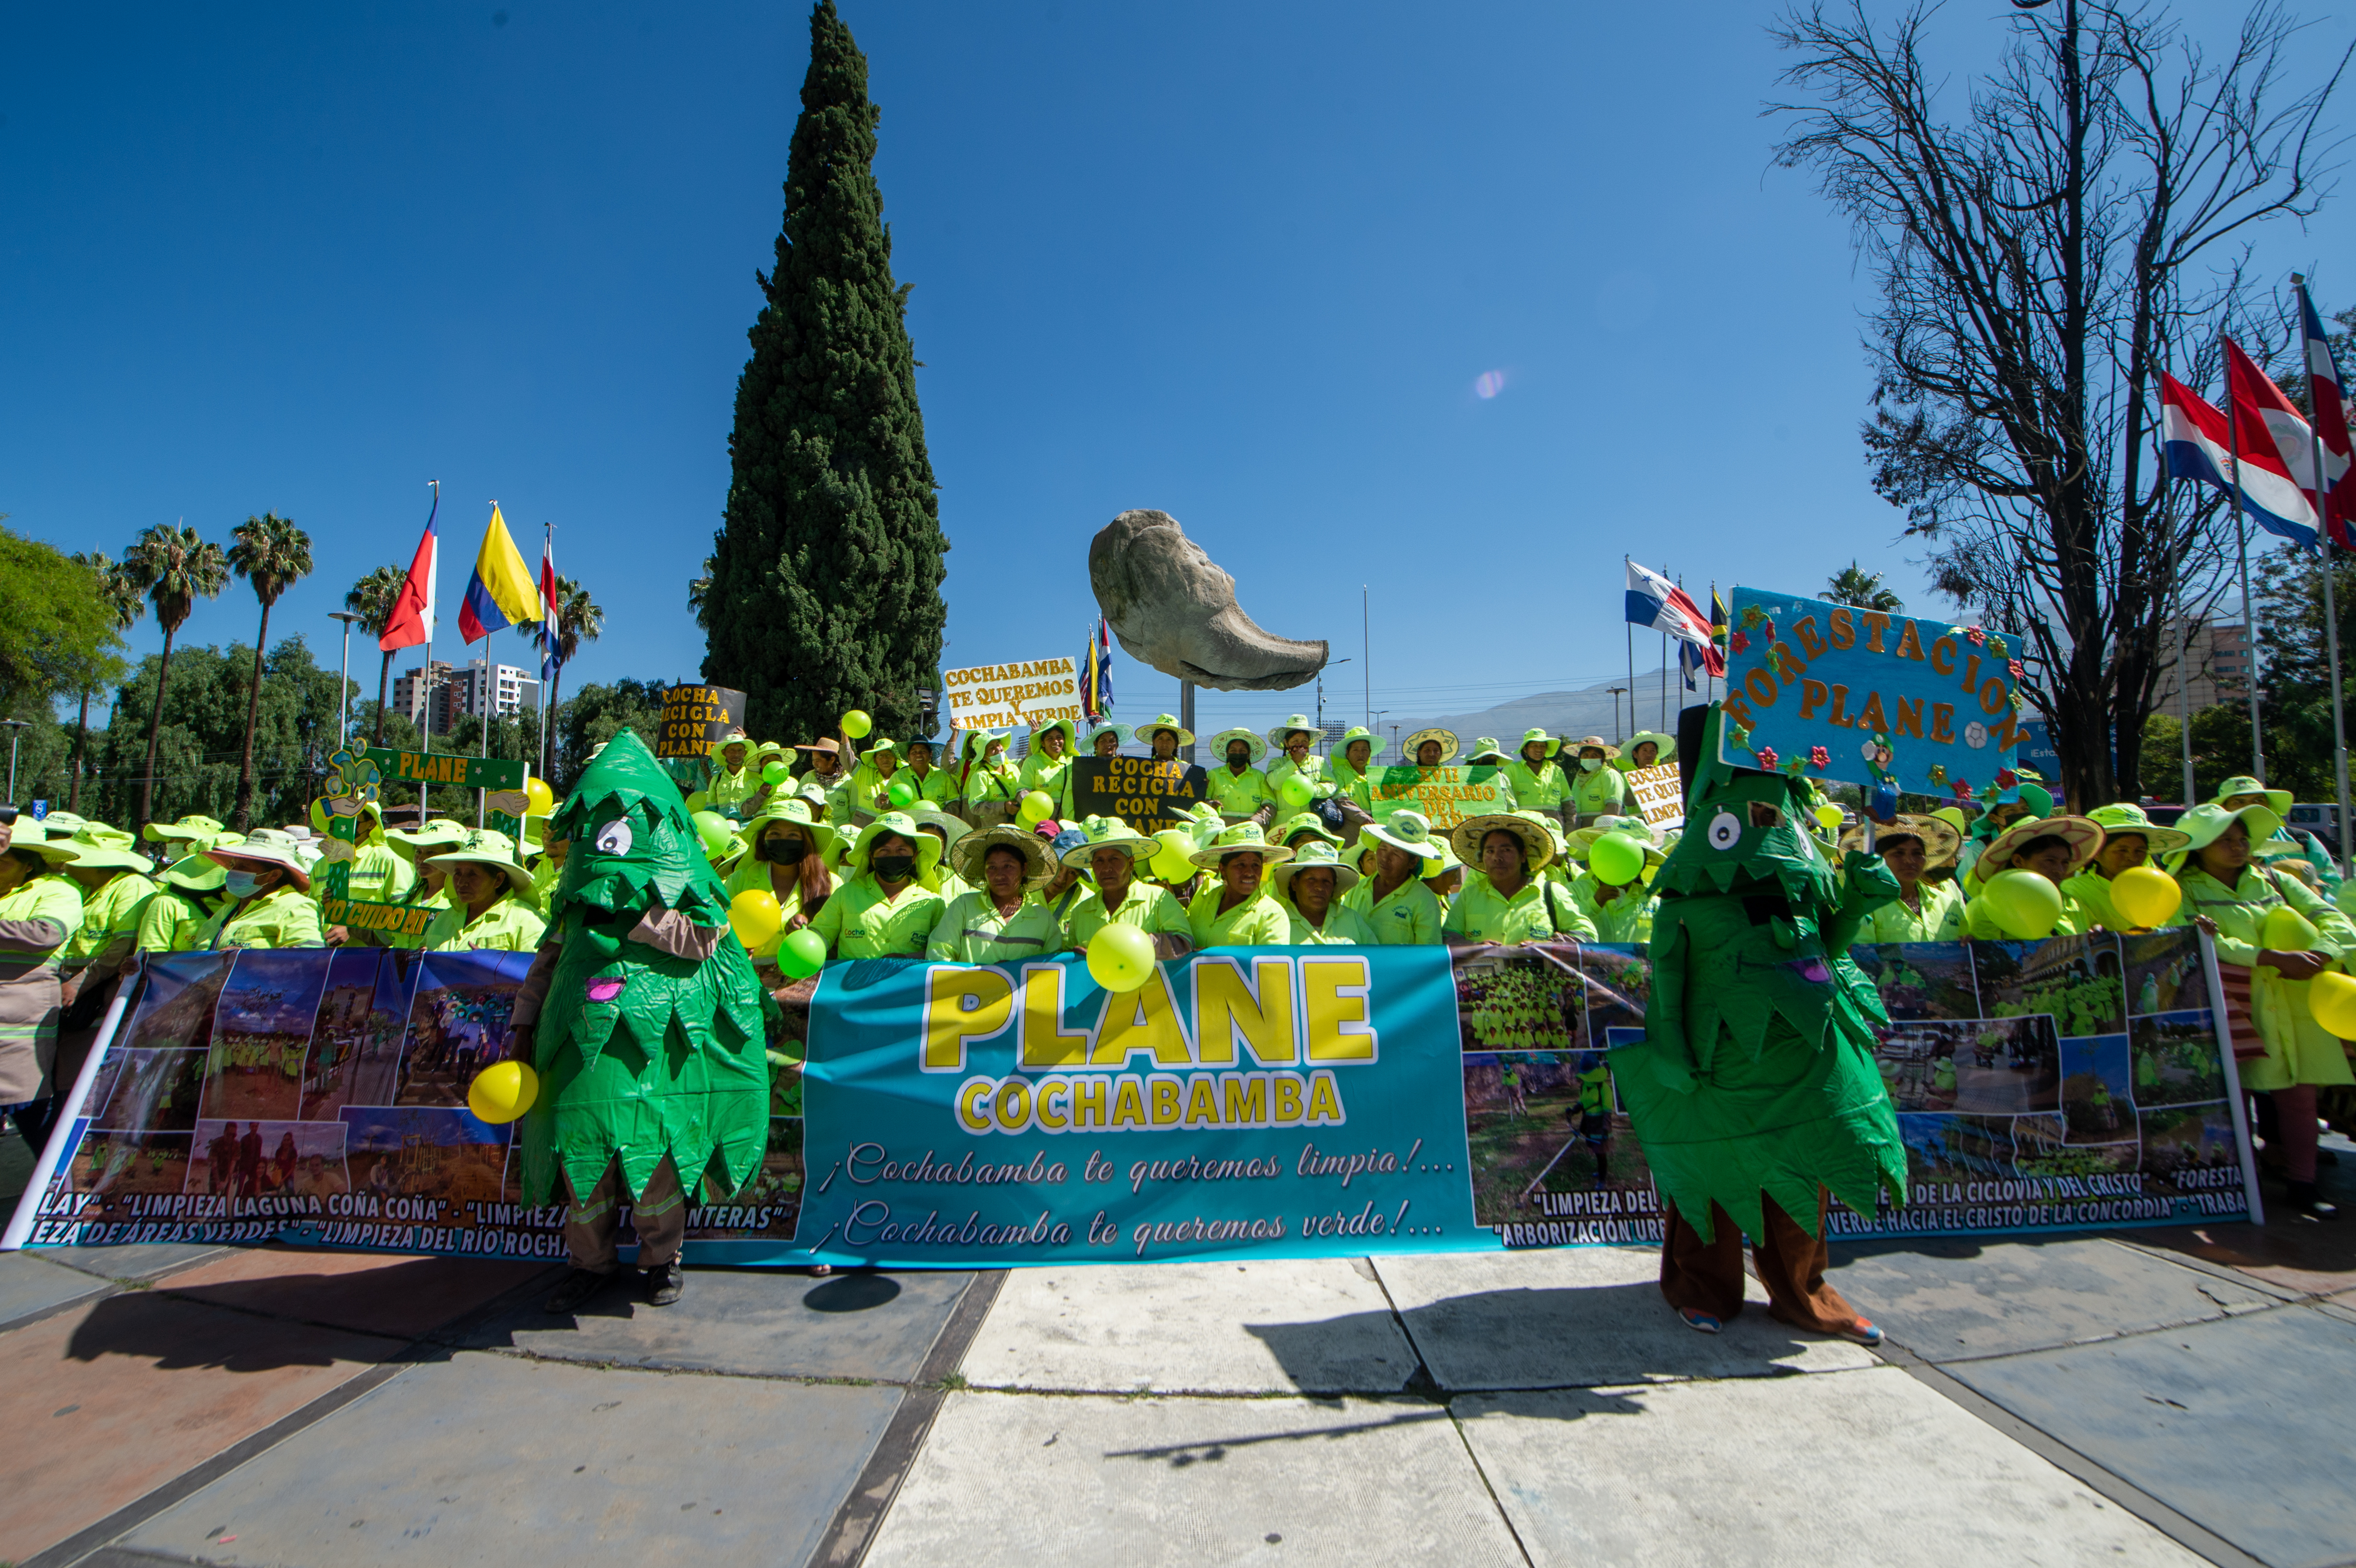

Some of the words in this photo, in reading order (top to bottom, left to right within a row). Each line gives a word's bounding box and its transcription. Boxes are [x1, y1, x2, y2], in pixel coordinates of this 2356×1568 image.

[945, 658, 1074, 687] COCHABAMBA
[1721, 608, 2032, 753] FORESTACION
[662, 687, 720, 705] COCHA
[948, 690, 973, 708] TE
[975, 679, 1075, 705] QUEREMOS
[954, 710, 1019, 730] LIMPIA
[1023, 705, 1081, 724] VERDE
[1009, 700, 1021, 716] Y
[1798, 678, 1955, 745] PLANE
[668, 723, 706, 738] CON
[658, 740, 716, 756] PLANE
[399, 752, 468, 783] PLANE
[1110, 758, 1183, 779] COCHA
[1417, 766, 1460, 783] XVII
[1092, 776, 1195, 798] RECICLA
[1370, 784, 1496, 801] ANIVERSARIO
[1634, 787, 1656, 804] TE
[1115, 797, 1159, 816] CON
[1422, 800, 1461, 816] DEL
[1643, 801, 1685, 825] LIMPI
[1425, 814, 1476, 830] LAN
[324, 899, 347, 923] YO
[346, 902, 406, 931] CUIDO
[401, 908, 430, 935] MI
[919, 956, 1379, 1074] PLANE
[954, 1069, 1347, 1136] COCHABAMBA
[818, 1140, 1069, 1195] ¡Cochabamba
[1085, 1150, 1115, 1183] te
[1130, 1151, 1283, 1195] queremos
[1296, 1138, 1454, 1188] limpia!...
[1625, 1190, 1657, 1213] DEL
[1916, 1183, 1937, 1204] DE
[1942, 1183, 1963, 1203] LA
[1967, 1174, 2043, 1202] CICLOVÍA
[2043, 1177, 2055, 1199] Y
[2056, 1175, 2089, 1199] DEL
[233, 1195, 322, 1218] LAGUNA
[328, 1191, 379, 1218] COÑA
[809, 1199, 1073, 1255] ¡Cochabamba
[1088, 1211, 1119, 1245] te
[1133, 1211, 1288, 1257] queremos
[1300, 1199, 1444, 1238] verde!...
[1827, 1211, 1884, 1234] VERDE
[1886, 1208, 1939, 1232] HACIA
[1943, 1208, 1962, 1229] EL
[1965, 1205, 2023, 1228] CRISTO
[2027, 1204, 2049, 1226] DE
[2053, 1203, 2074, 1224] LA
[86, 1221, 121, 1244] DE
[122, 1217, 199, 1243] ÁREAS
[419, 1229, 455, 1251] DEL
[460, 1225, 498, 1253] RÍO
